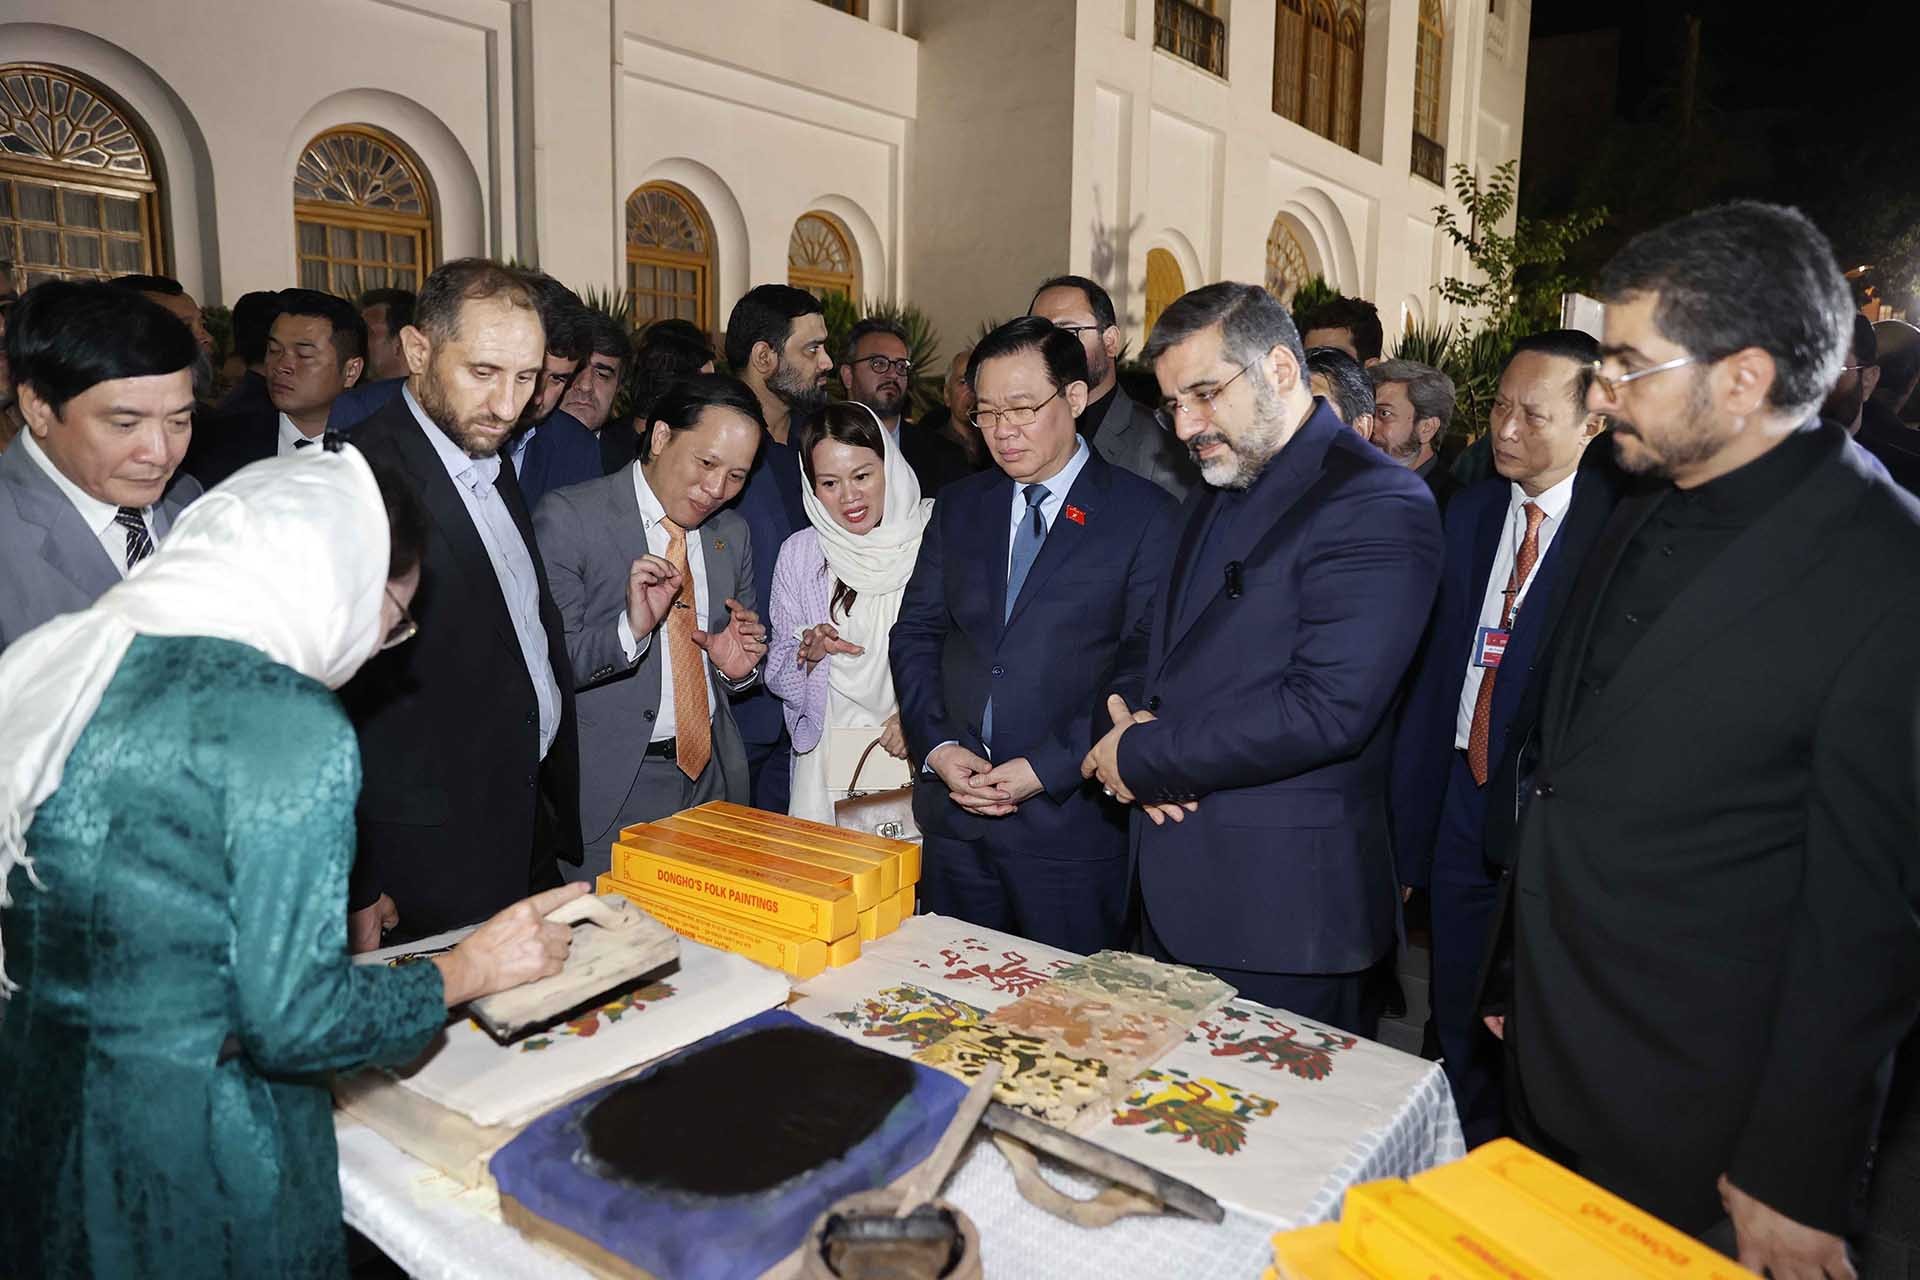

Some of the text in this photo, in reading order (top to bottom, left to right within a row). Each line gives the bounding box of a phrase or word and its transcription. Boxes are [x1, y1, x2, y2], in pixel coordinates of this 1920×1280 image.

[657, 869, 778, 913] DONGHO'S FOLK PAINTINGS
